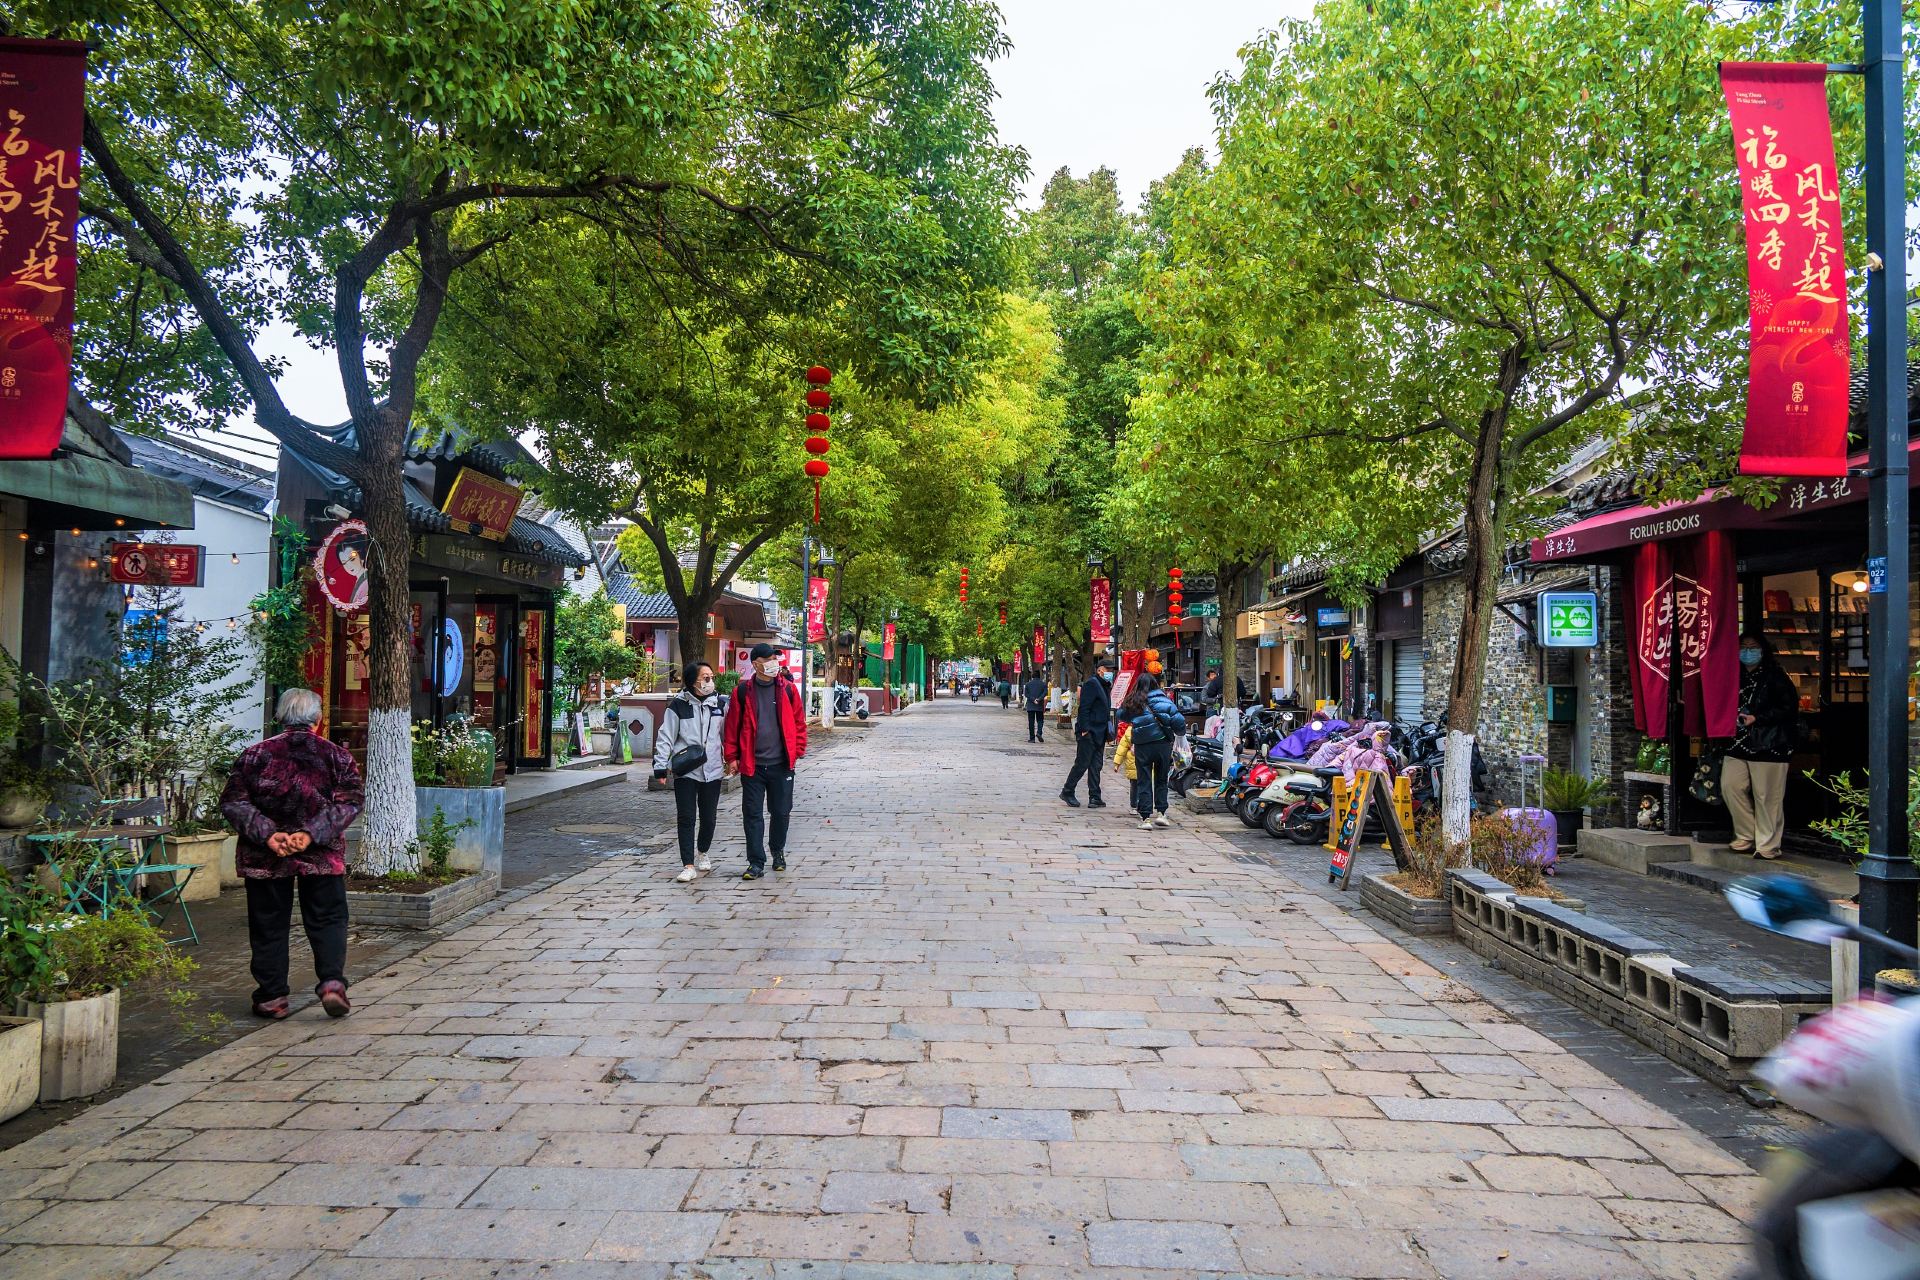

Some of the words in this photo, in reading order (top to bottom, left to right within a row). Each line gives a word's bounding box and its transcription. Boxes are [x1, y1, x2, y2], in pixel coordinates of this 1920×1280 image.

[1740, 124, 1791, 271] 福暖四季
[1789, 477, 1852, 509] 浮生記
[1629, 521, 1665, 540] FORLIVE
[1666, 514, 1700, 532] BOOKS
[1545, 536, 1577, 557] 浮生記
[1339, 808, 1347, 822] P
[1404, 811, 1410, 821] P
